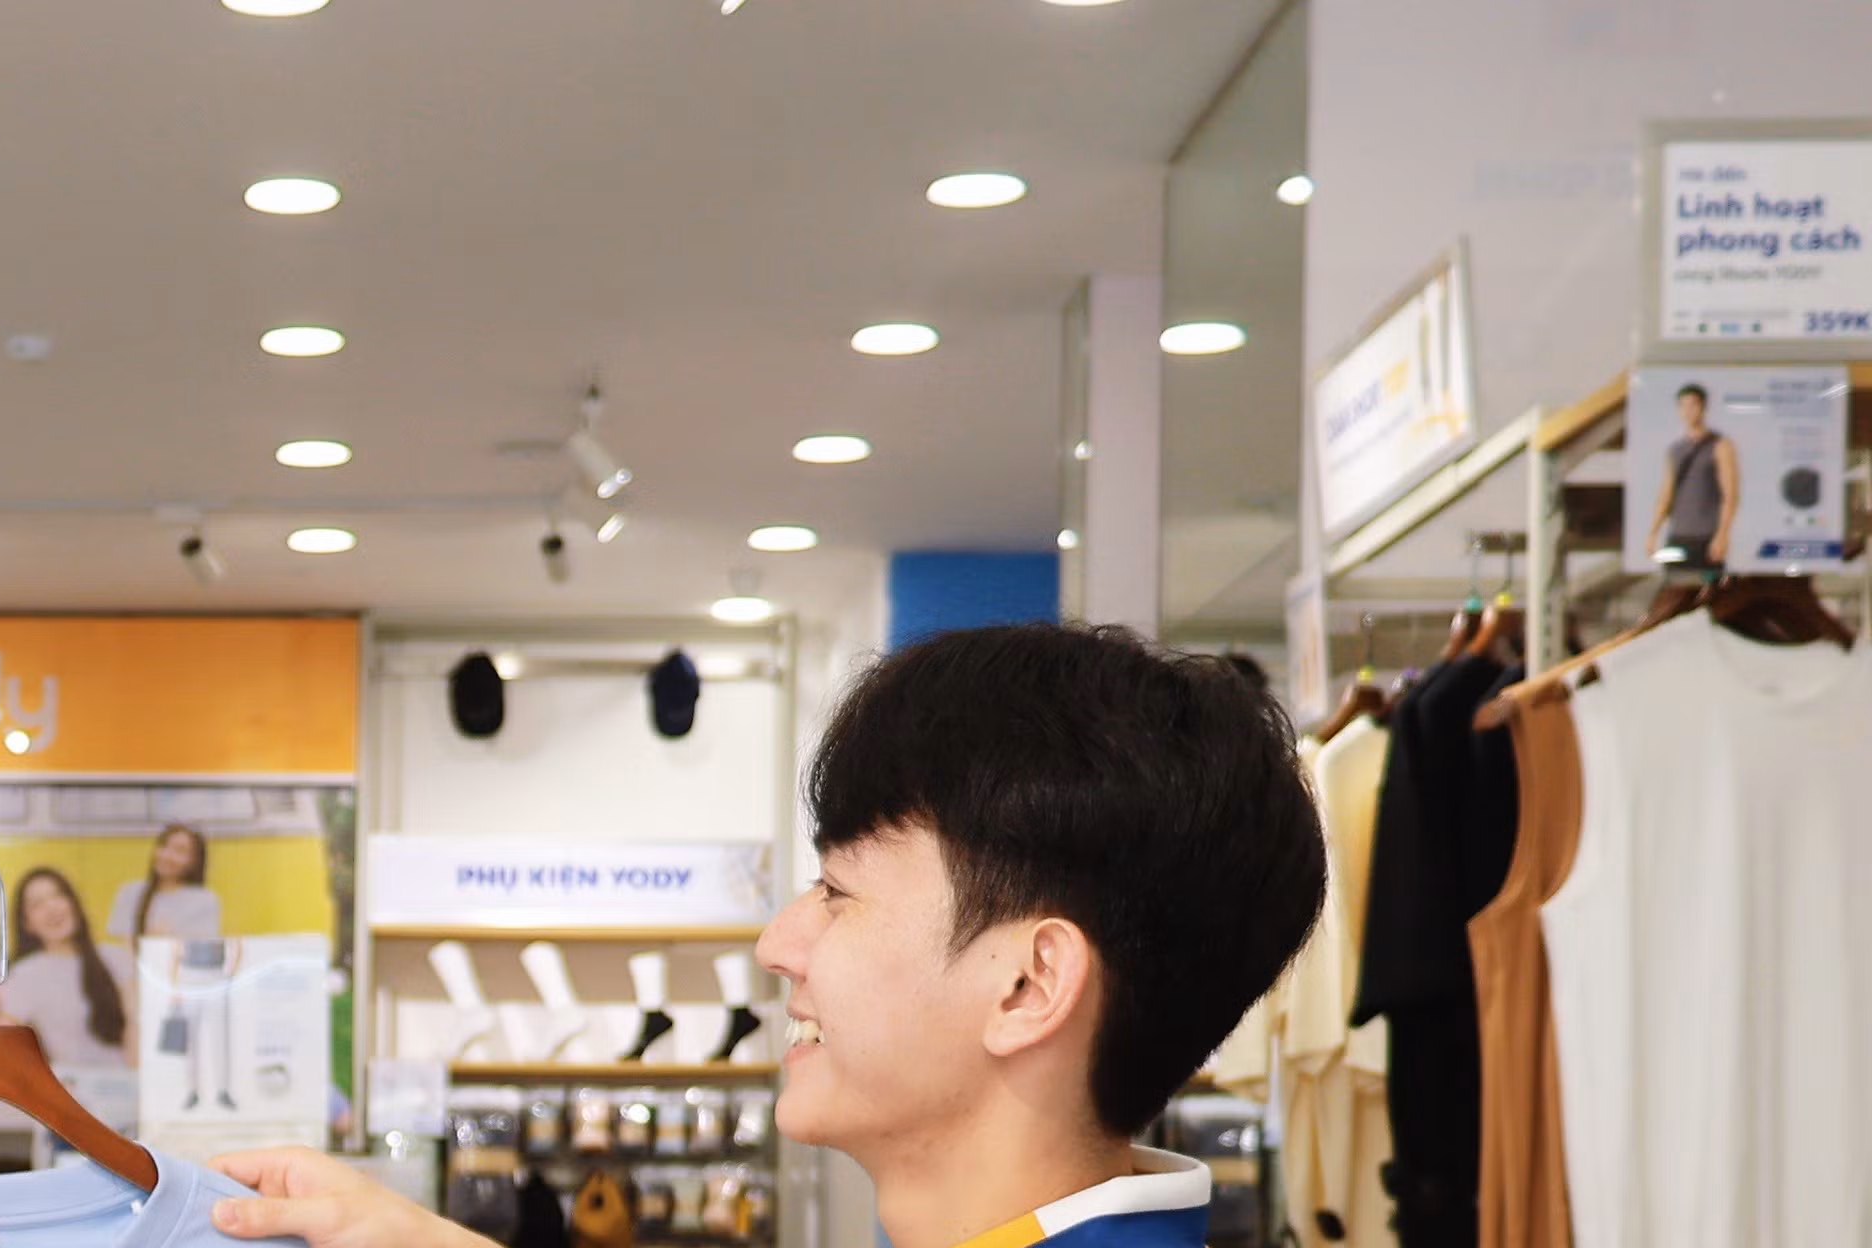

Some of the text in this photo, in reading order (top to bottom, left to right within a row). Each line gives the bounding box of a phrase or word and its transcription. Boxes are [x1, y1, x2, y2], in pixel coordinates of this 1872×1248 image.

[1679, 192, 1825, 223] Linh hoạt
[1677, 224, 1861, 259] phong cách
[1805, 310, 1870, 332] 359K
[456, 865, 517, 895] PHỤ
[612, 867, 693, 890] YODY
